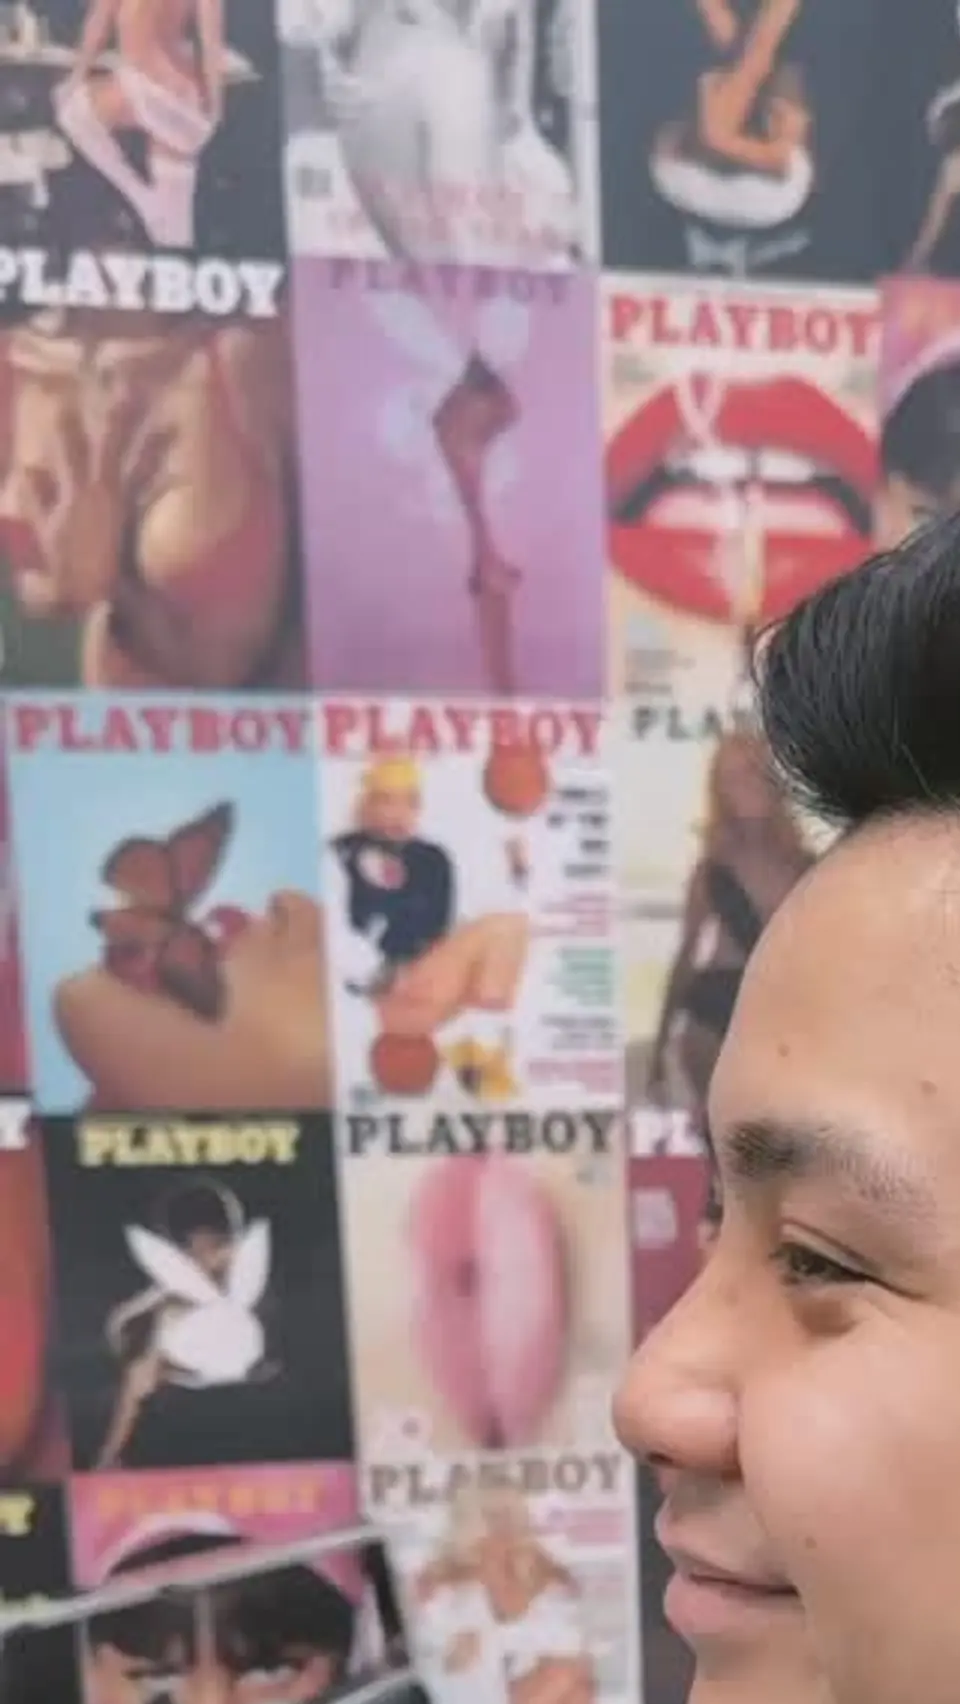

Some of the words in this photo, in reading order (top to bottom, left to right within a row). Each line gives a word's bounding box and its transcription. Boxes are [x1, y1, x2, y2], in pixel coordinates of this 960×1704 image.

[609, 295, 876, 356] PLAYBOY
[12, 705, 308, 757] PLAYBOY
[322, 703, 604, 755] PLAYBOY
[80, 1117, 299, 1168] PLAYBOY
[345, 1112, 614, 1154] PLAYBOY
